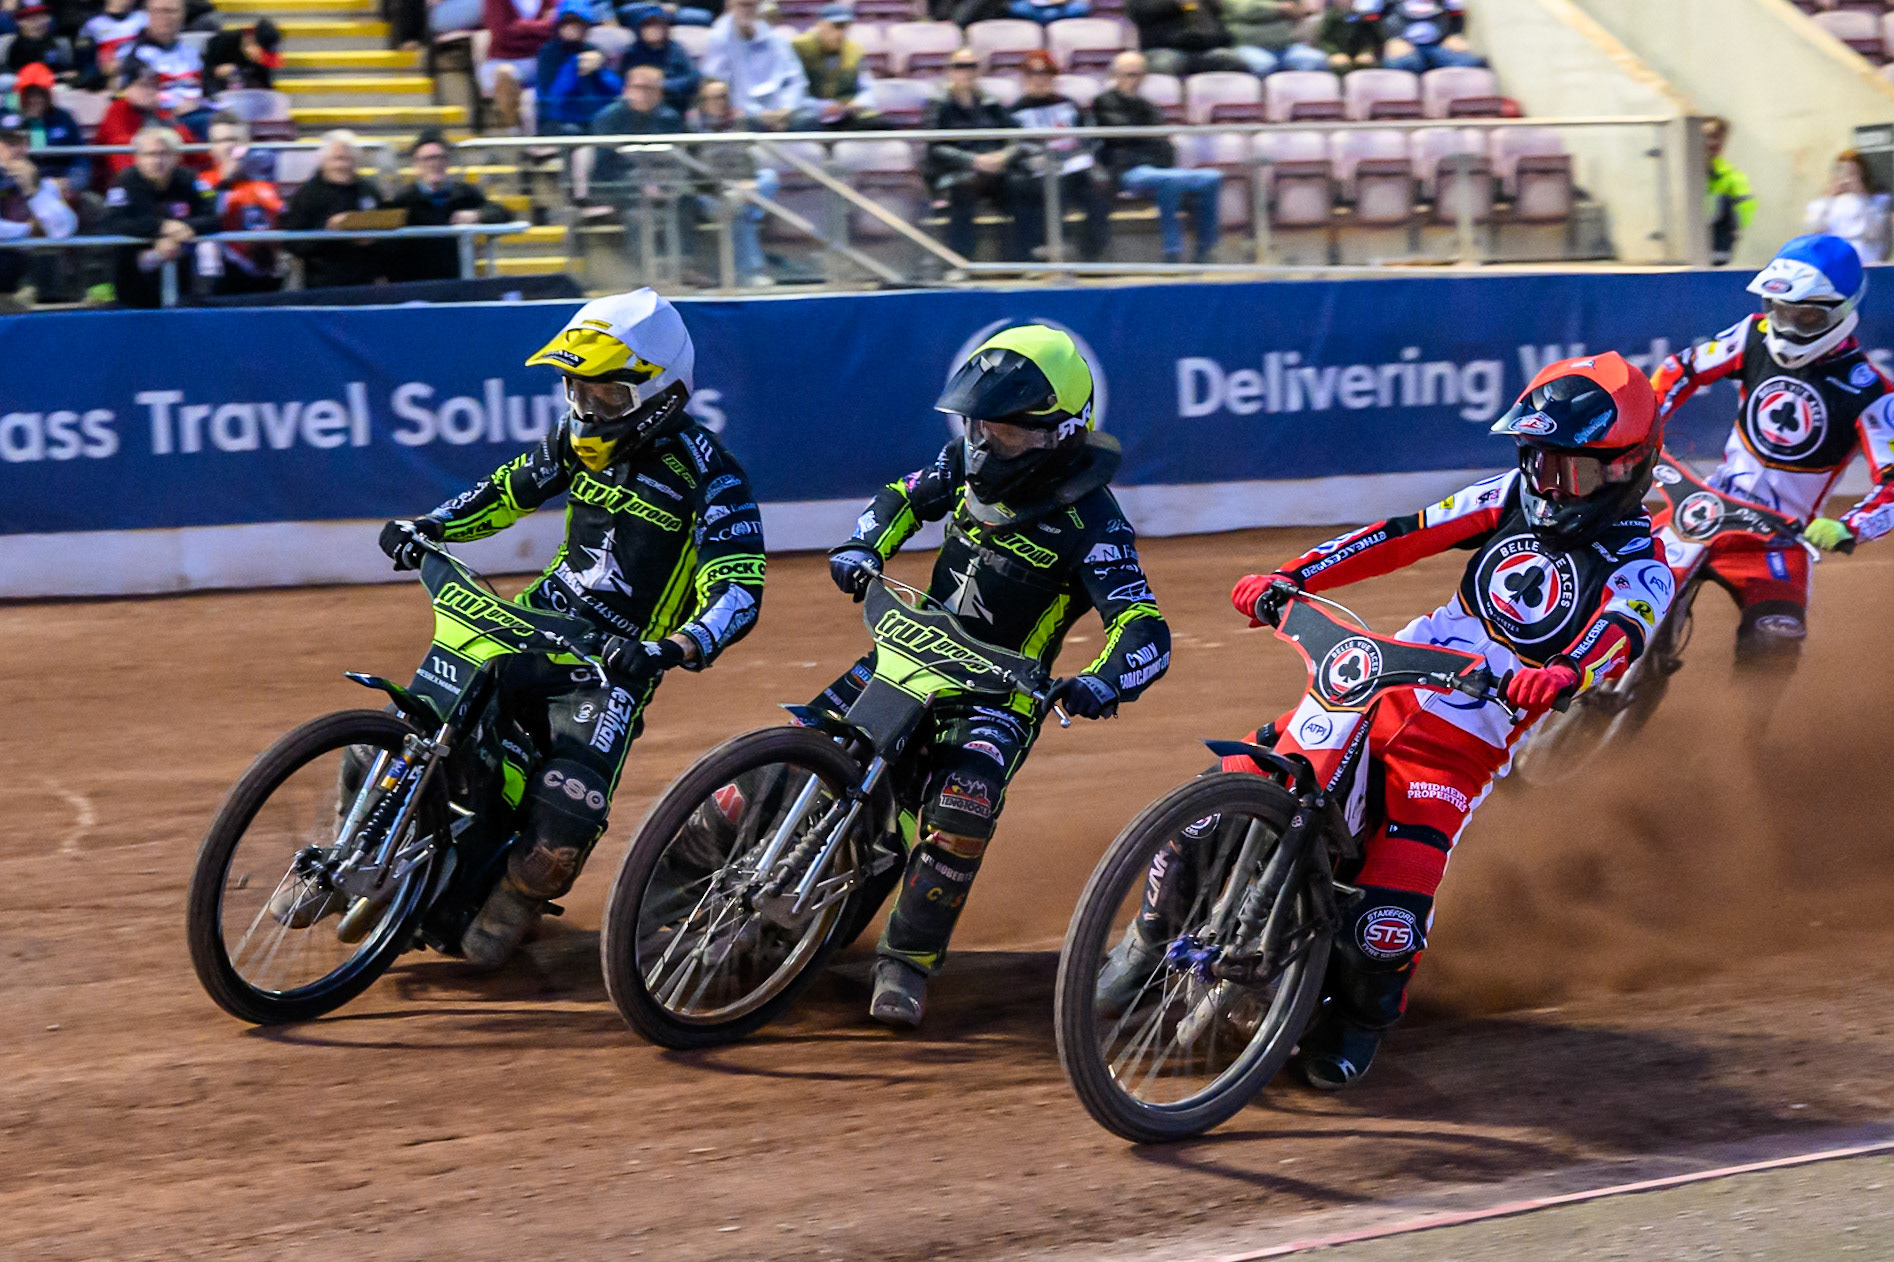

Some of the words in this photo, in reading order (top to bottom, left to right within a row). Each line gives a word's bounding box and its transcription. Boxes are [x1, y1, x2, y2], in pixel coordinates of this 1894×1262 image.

[1177, 347, 1501, 423] Delivering
[0, 410, 119, 463] ass
[135, 381, 369, 456] Travel
[392, 379, 727, 446] Solus
[708, 562, 755, 582] ROCK
[1500, 541, 1540, 558] BELLE
[1560, 573, 1573, 608] ACES
[1357, 641, 1372, 652] VUE
[1369, 651, 1379, 672] ACES
[1304, 722, 1328, 737] ATPI
[1407, 790, 1468, 813] PROPERTIES
[1366, 909, 1415, 925] STAKEFORD
[1366, 924, 1411, 944] STS
